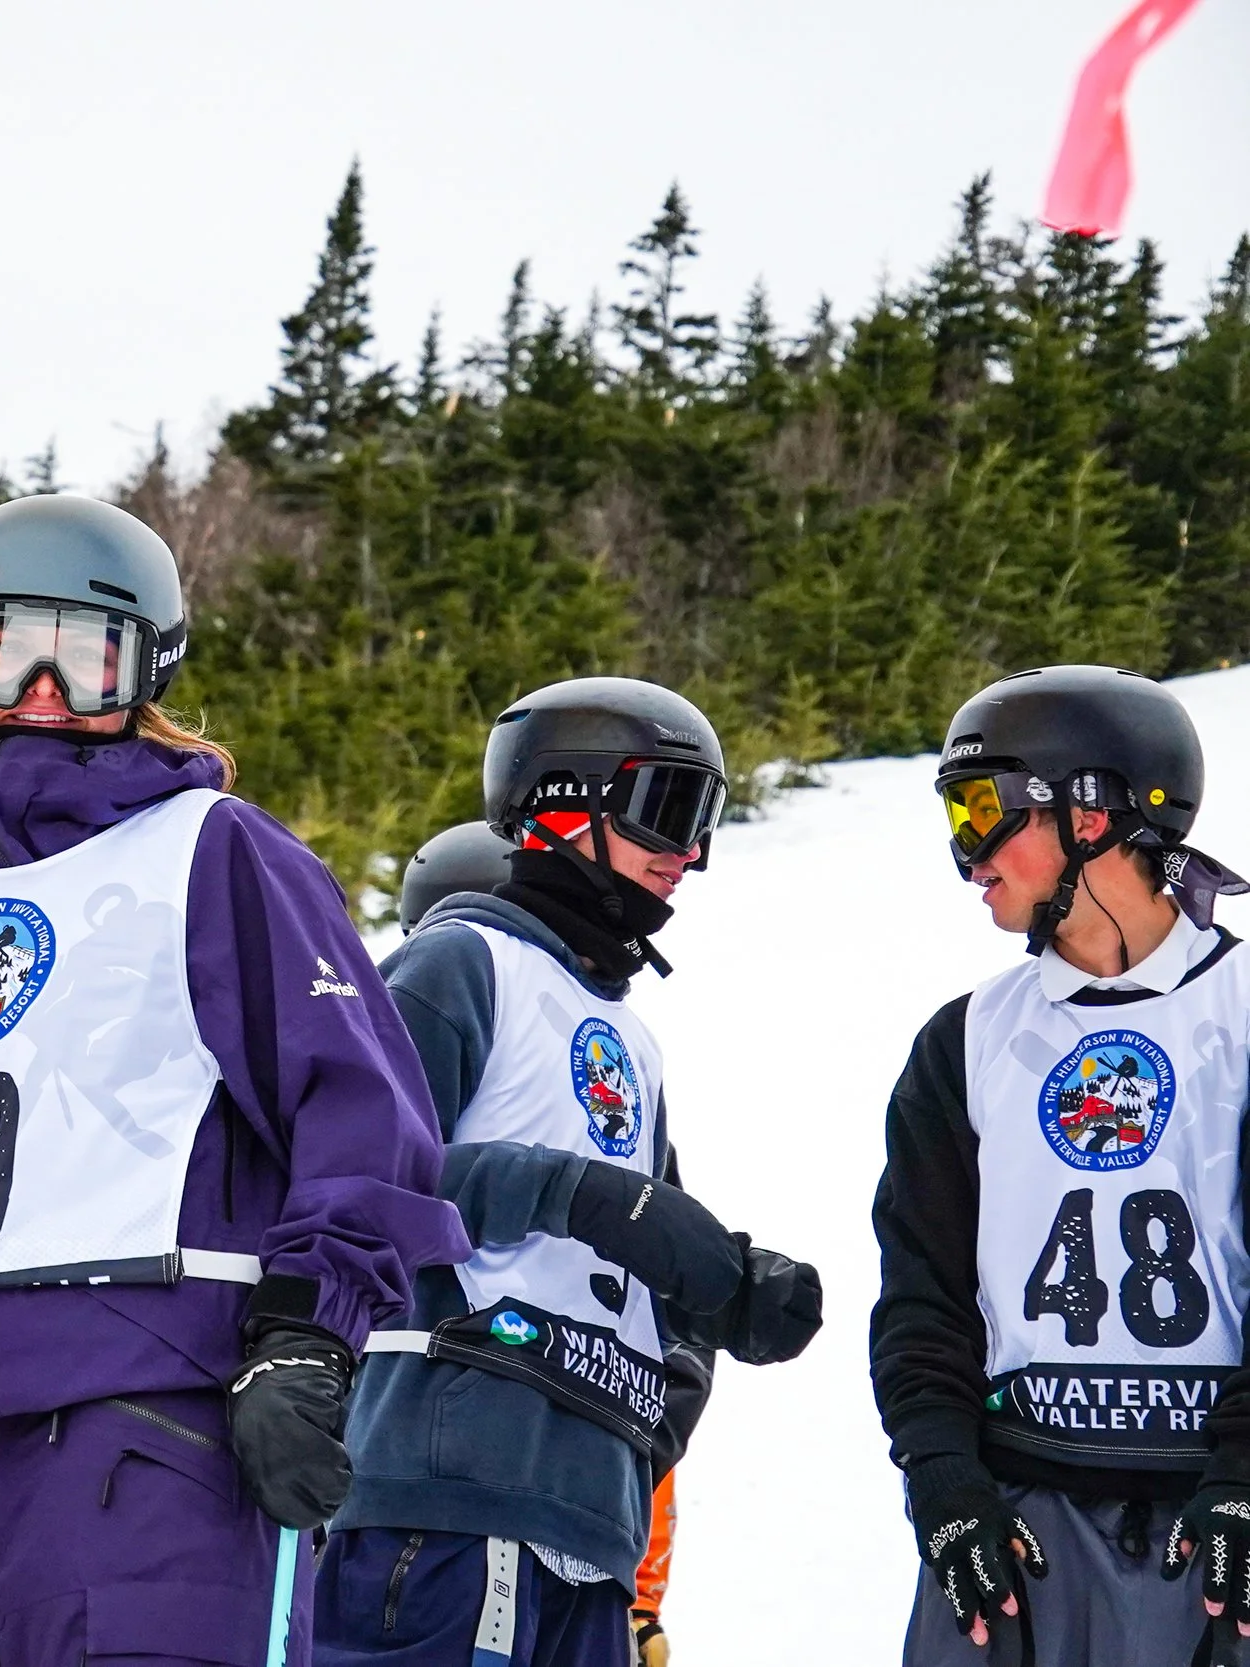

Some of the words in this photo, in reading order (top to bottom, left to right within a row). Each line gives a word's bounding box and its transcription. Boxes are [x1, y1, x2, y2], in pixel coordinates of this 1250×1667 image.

[659, 727, 699, 745] SMITH
[948, 743, 982, 760] GIRO
[10, 903, 50, 964] INVITATIONAL
[0, 979, 40, 1029] RESORT
[574, 1051, 583, 1071] THE
[1045, 1081, 1060, 1103] THE
[1056, 1033, 1117, 1079] HENDERSON
[1121, 1033, 1171, 1092] INVITATIONAL
[1046, 1120, 1092, 1167] WATERVILLE
[1098, 1152, 1141, 1168] VALLEY
[1143, 1108, 1168, 1153] RESORT
[630, 1189, 651, 1220] Columbia
[1023, 1188, 1210, 1348] 48
[561, 1325, 667, 1407] WATERVILL
[564, 1348, 623, 1399] VALLEY
[1024, 1375, 1218, 1407] WATERVI
[1028, 1403, 1151, 1431] VALLEY
